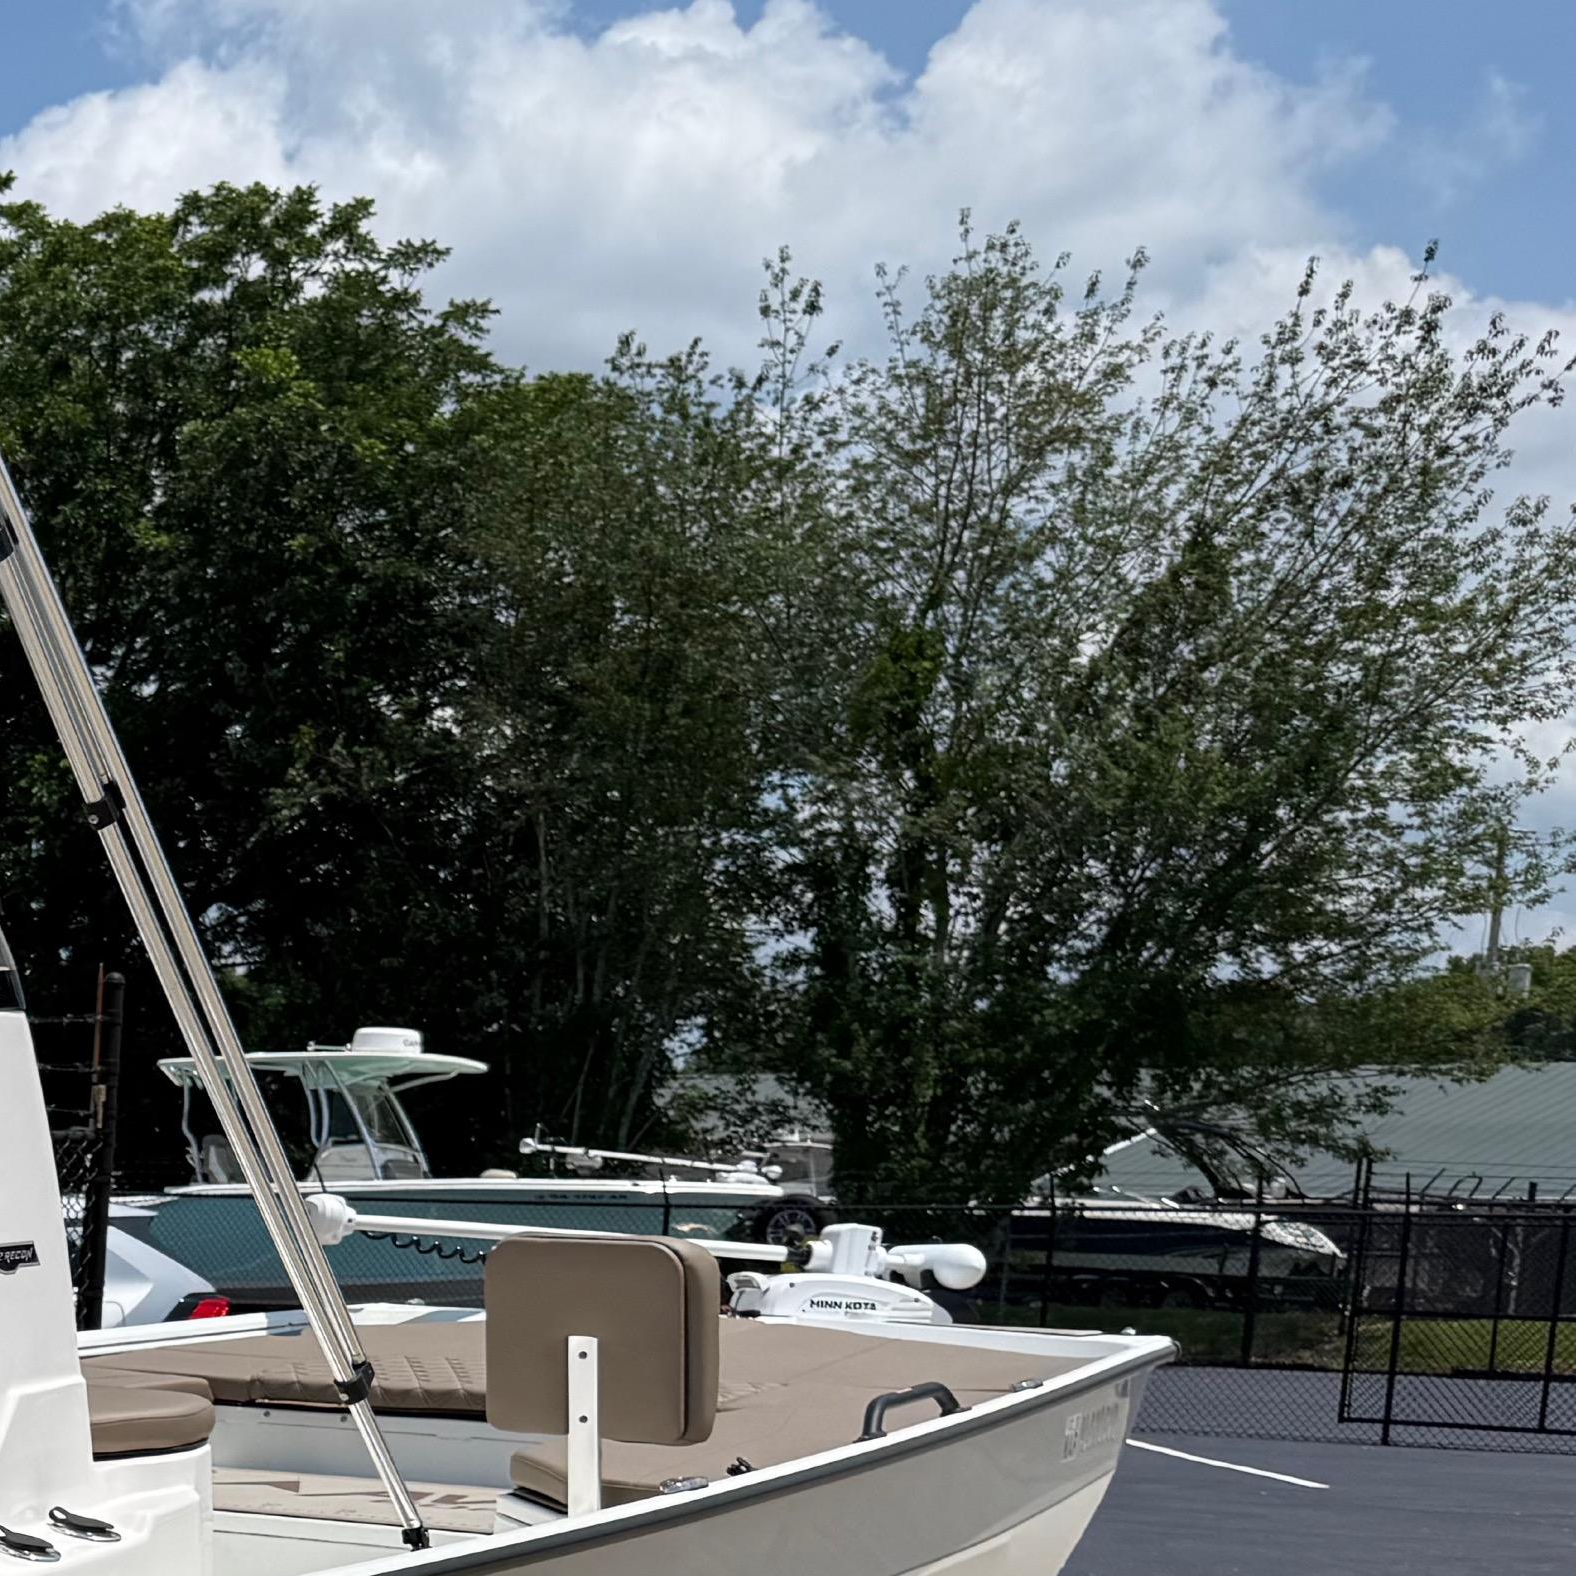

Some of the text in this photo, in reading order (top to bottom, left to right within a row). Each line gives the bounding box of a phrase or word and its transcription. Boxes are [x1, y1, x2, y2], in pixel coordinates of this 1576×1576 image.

[4, 1247, 34, 1264] RECON
[809, 1299, 877, 1311] MINN KOTA
